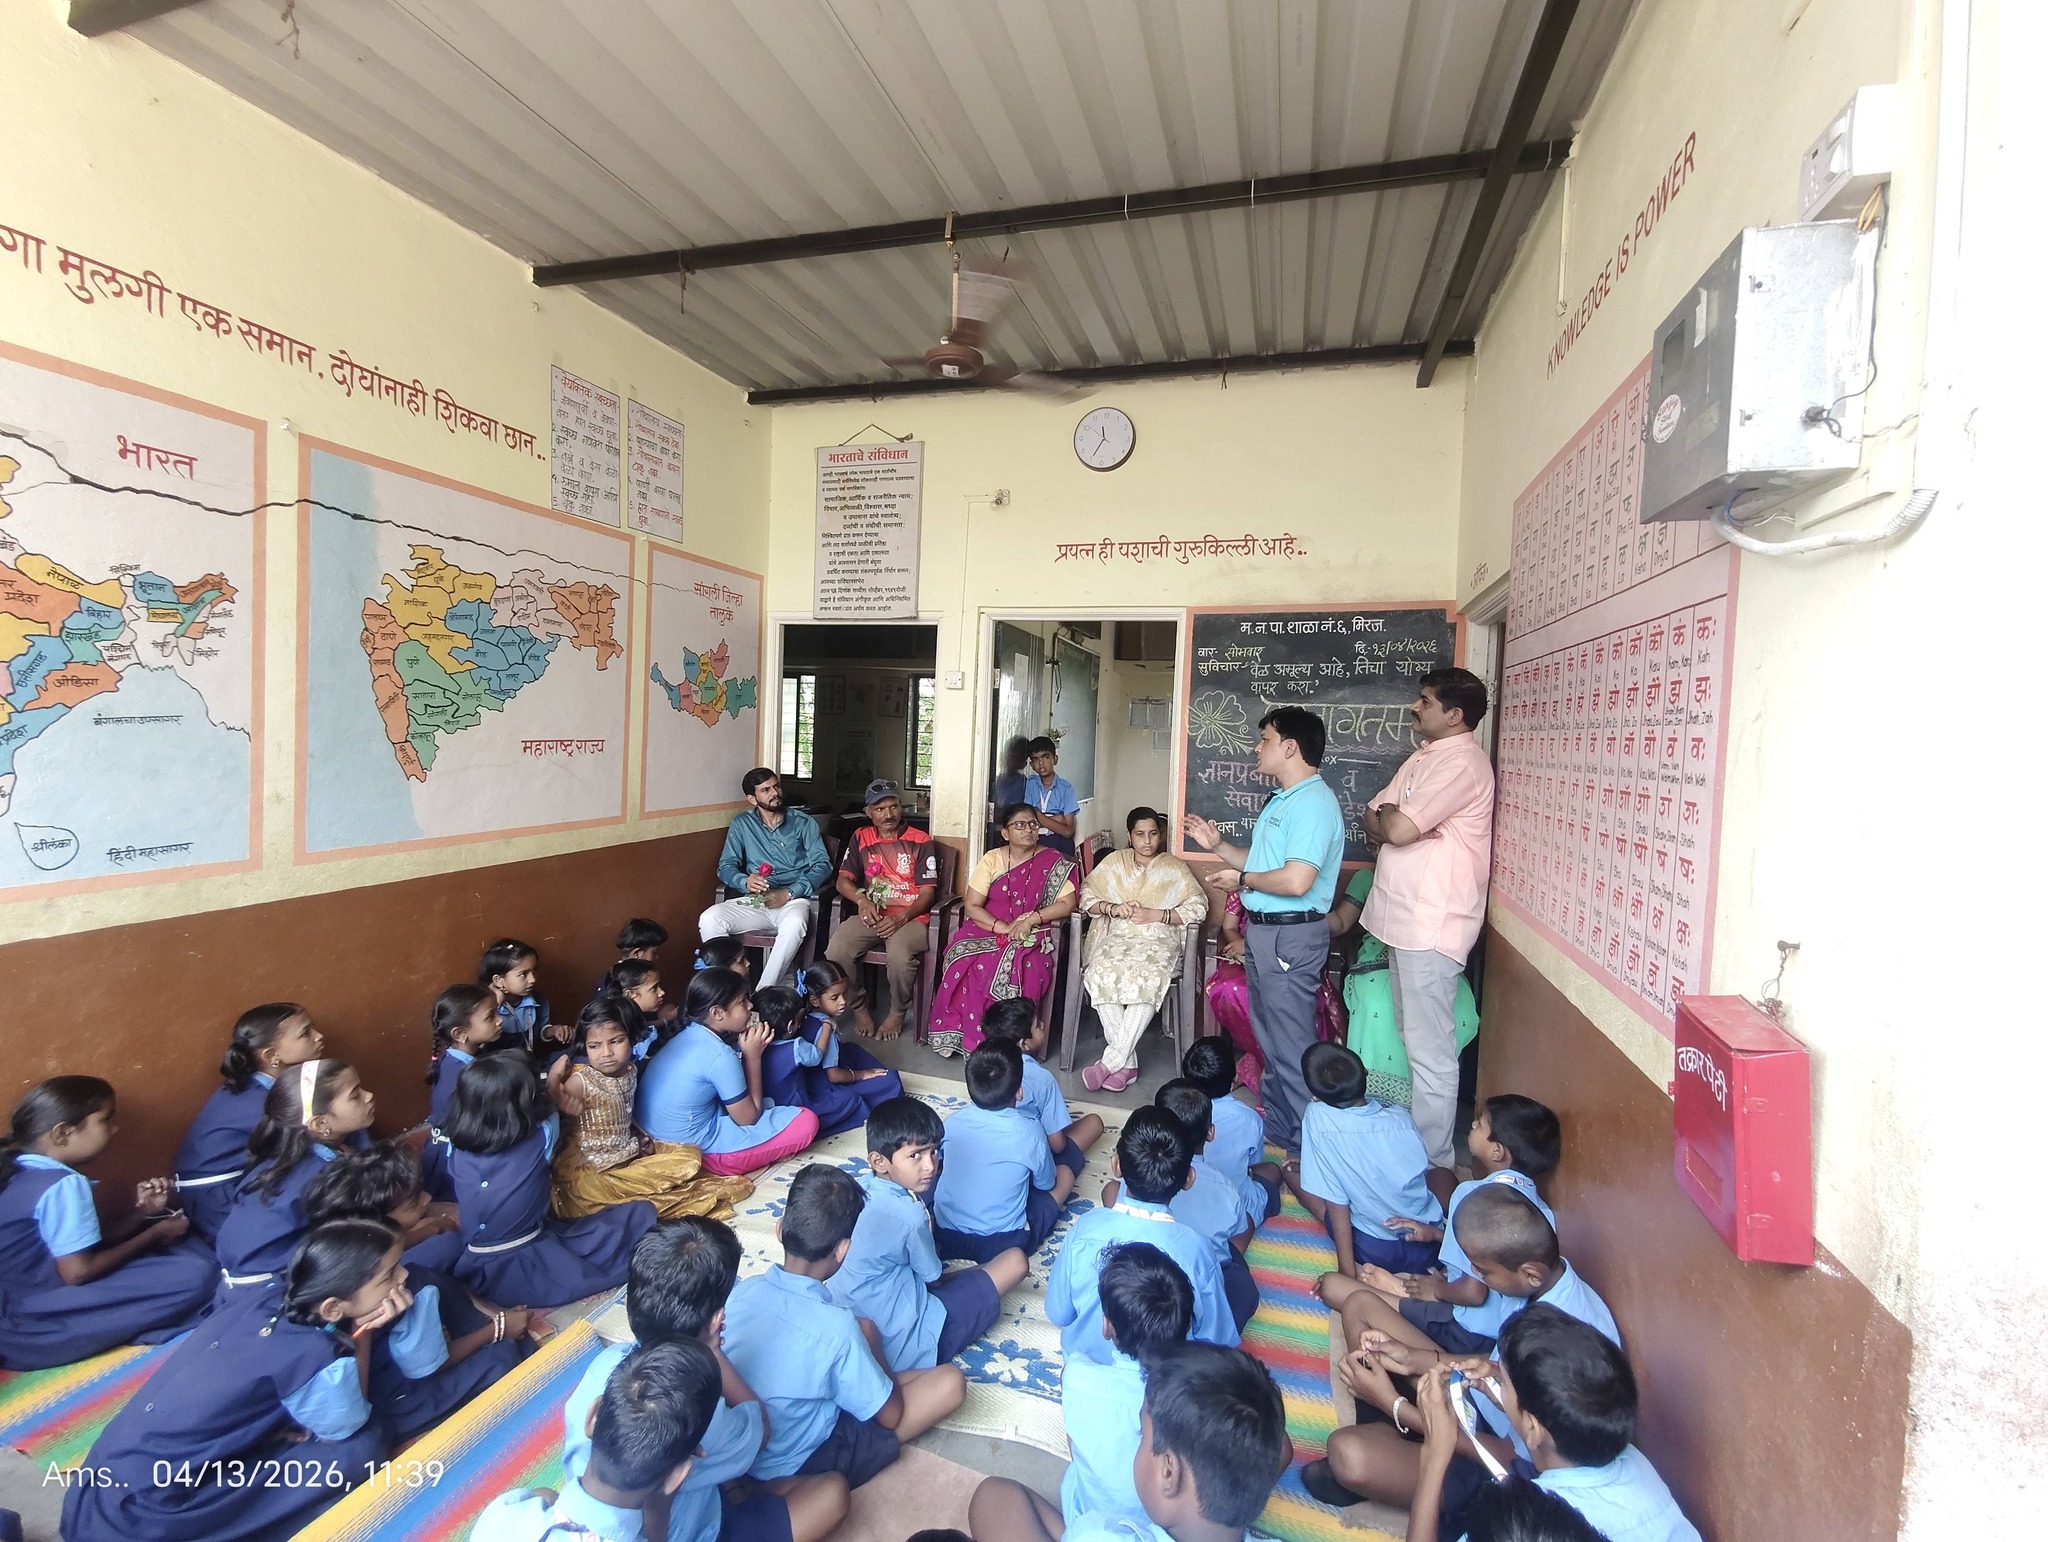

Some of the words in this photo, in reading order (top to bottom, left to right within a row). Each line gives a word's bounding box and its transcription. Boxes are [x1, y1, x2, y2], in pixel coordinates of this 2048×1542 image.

[1547, 256, 1613, 381] KNOWLEDGE
[1616, 233, 1630, 281] IS
[1633, 131, 1696, 256] POWER
[56, 246, 172, 318] मुलगी
[176, 292, 232, 339] एक
[328, 349, 428, 417] दोघांनाही
[433, 388, 498, 443] शिकवा
[117, 434, 198, 480] भारत
[828, 448, 864, 463] भारताचे
[868, 447, 909, 461] संविधान
[1054, 542, 1096, 563] प्रयत्न
[1098, 538, 1116, 566] ही
[1118, 534, 1172, 564] यशाची
[1173, 533, 1260, 565] गुरुकिल्ली
[46, 566, 84, 591] नेपाळ
[4, 590, 40, 606] प्रदेश
[85, 606, 112, 621] बिहार
[1286, 620, 1320, 634] शाळा
[1224, 642, 1266, 662] सोमवार
[1273, 663, 1314, 678] अमूल्य
[1353, 656, 1387, 675] तिचा
[1250, 681, 1280, 697] वापर
[522, 739, 574, 758] महाराष्ट्र
[576, 739, 606, 754] राज्य
[32, 837, 72, 852] श्रीलंका
[1676, 1046, 1707, 1082] तक्रार
[1705, 1052, 1728, 1112] पेटी
